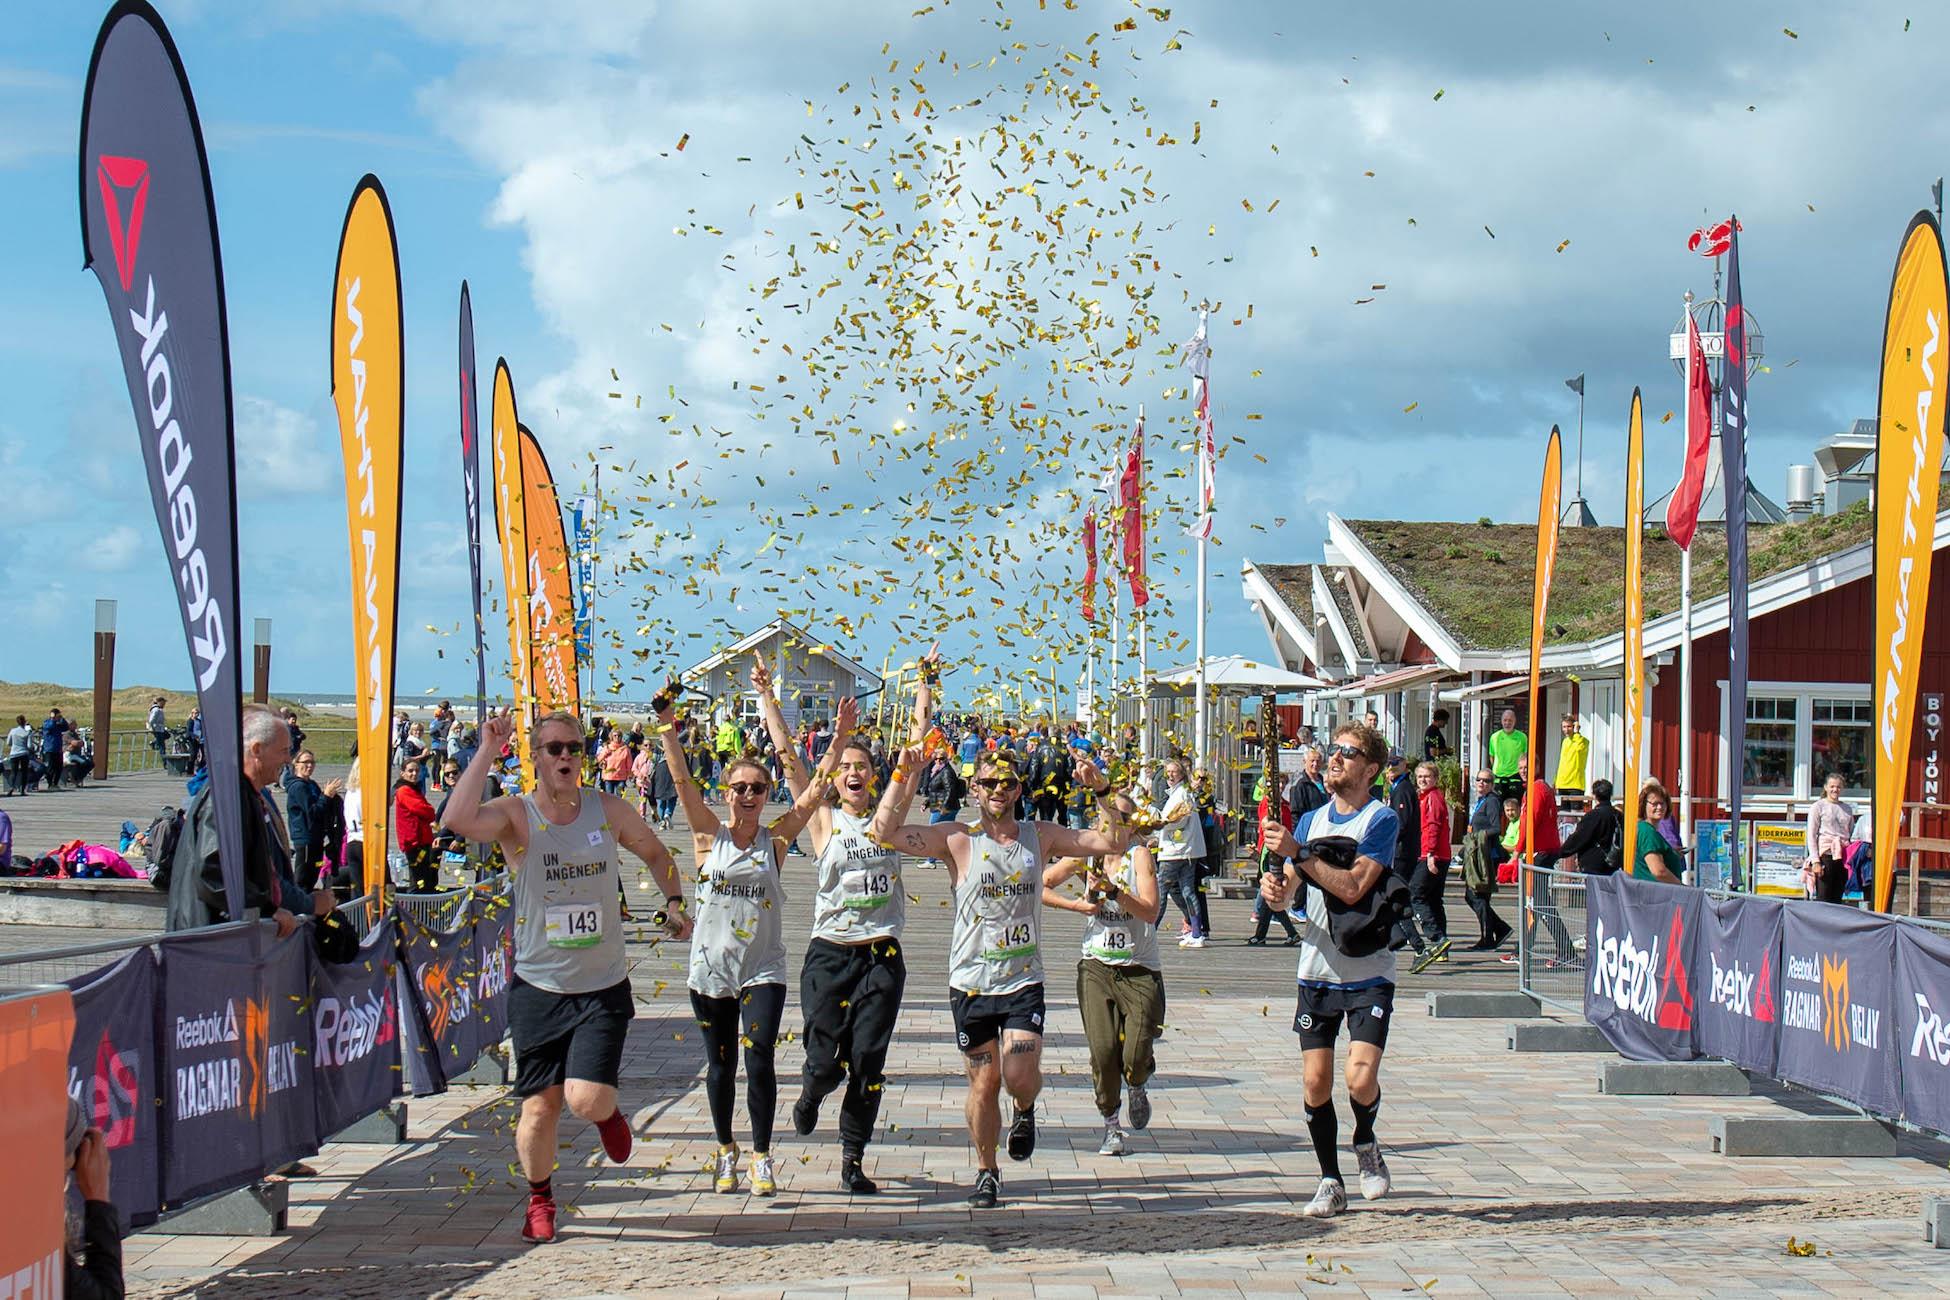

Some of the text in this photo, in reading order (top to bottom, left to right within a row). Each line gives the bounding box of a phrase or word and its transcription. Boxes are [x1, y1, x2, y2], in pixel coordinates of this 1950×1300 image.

[1890, 309, 1940, 676] NATHAN
[1926, 698, 1940, 741] BOY
[843, 837, 857, 849] UN
[1758, 830, 1803, 838] EIDERFAHRT
[543, 853, 558, 867] UN
[546, 861, 607, 882] ANGENEHM
[712, 870, 725, 881] UN
[981, 873, 994, 884] UN
[710, 883, 765, 899] ANGENEHM
[864, 874, 888, 895] 143
[981, 883, 1035, 899] ANGENEHM
[568, 911, 597, 935] 143
[1005, 924, 1030, 947] 143
[1104, 932, 1125, 949] 143
[1787, 956, 1814, 981] Reebok
[1783, 990, 1879, 1049] RAGNAR RELAY
[1911, 993, 1950, 1066] Re
[176, 1011, 223, 1050] Reebok
[177, 1058, 241, 1121] RAGNAR
